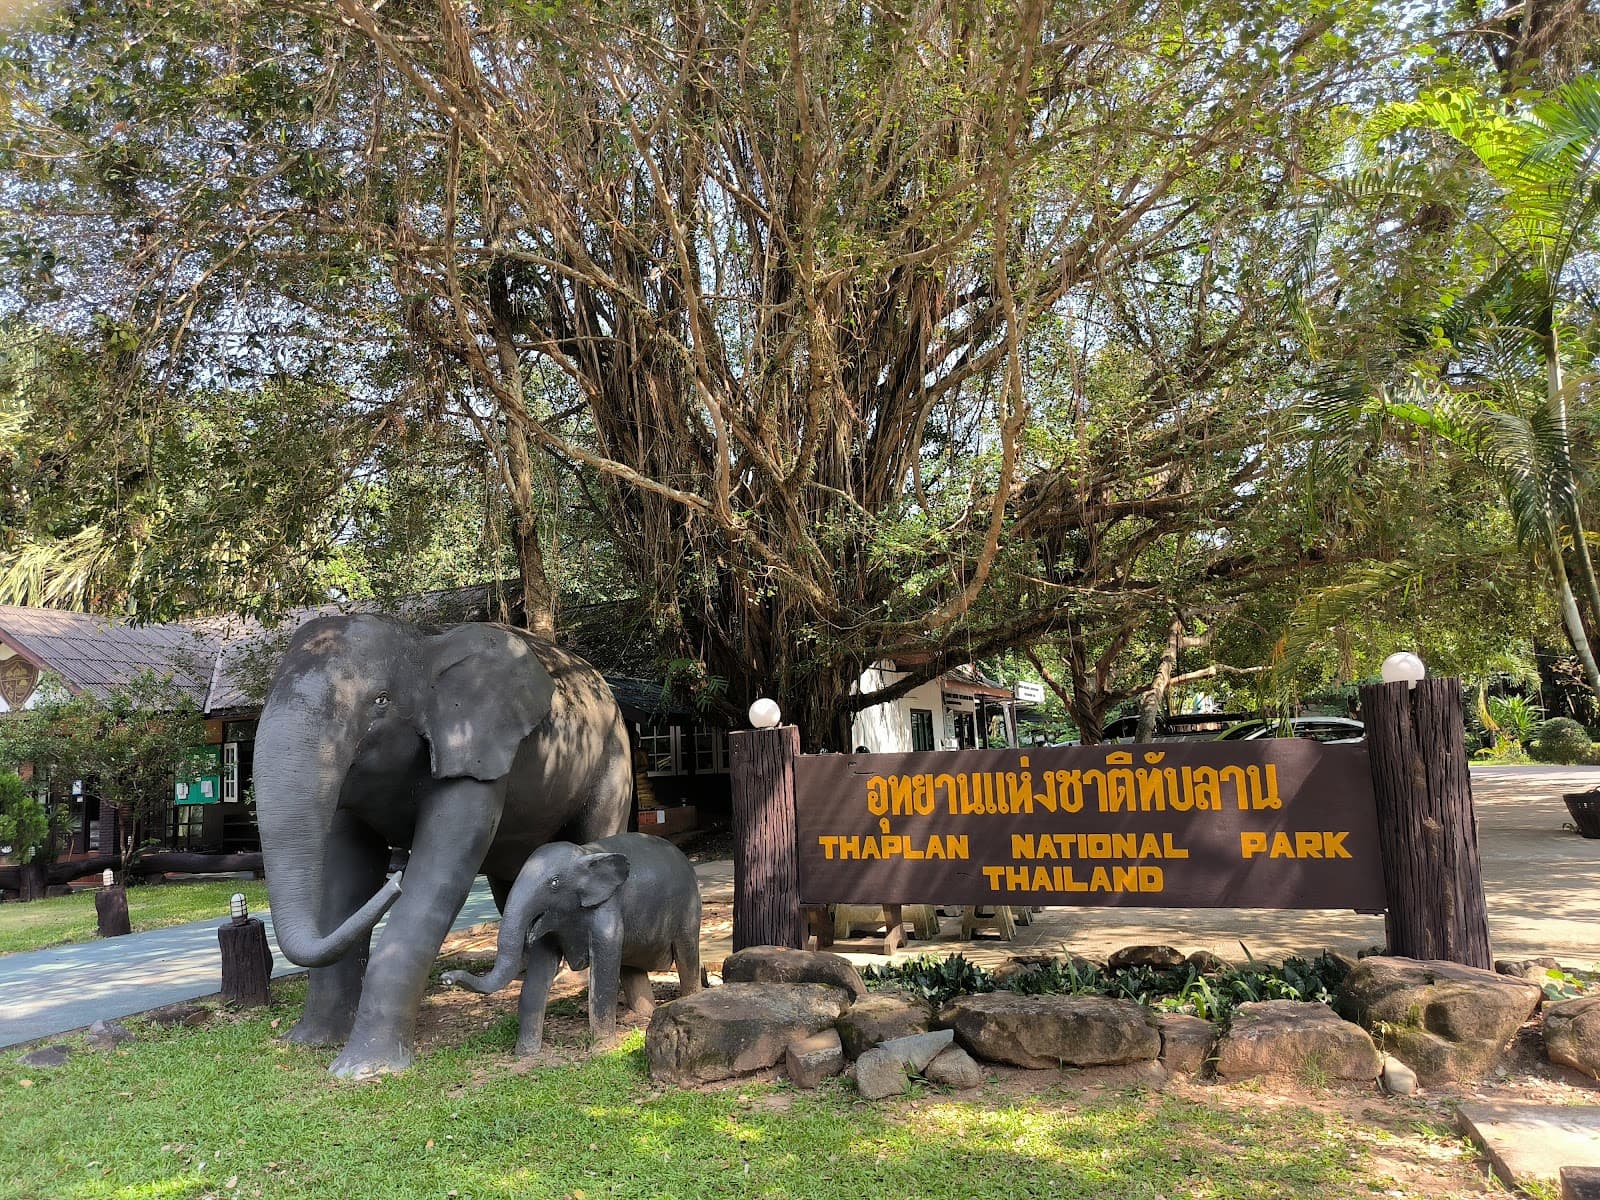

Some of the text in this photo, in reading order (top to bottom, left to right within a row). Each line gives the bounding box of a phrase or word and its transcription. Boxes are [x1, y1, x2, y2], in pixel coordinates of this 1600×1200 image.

[866, 751, 1283, 834] อุทยานแห่งชาติทับลาน
[818, 831, 1353, 860] THAPLAN NATIONAL PARK
[982, 866, 1164, 893] THAILAND
